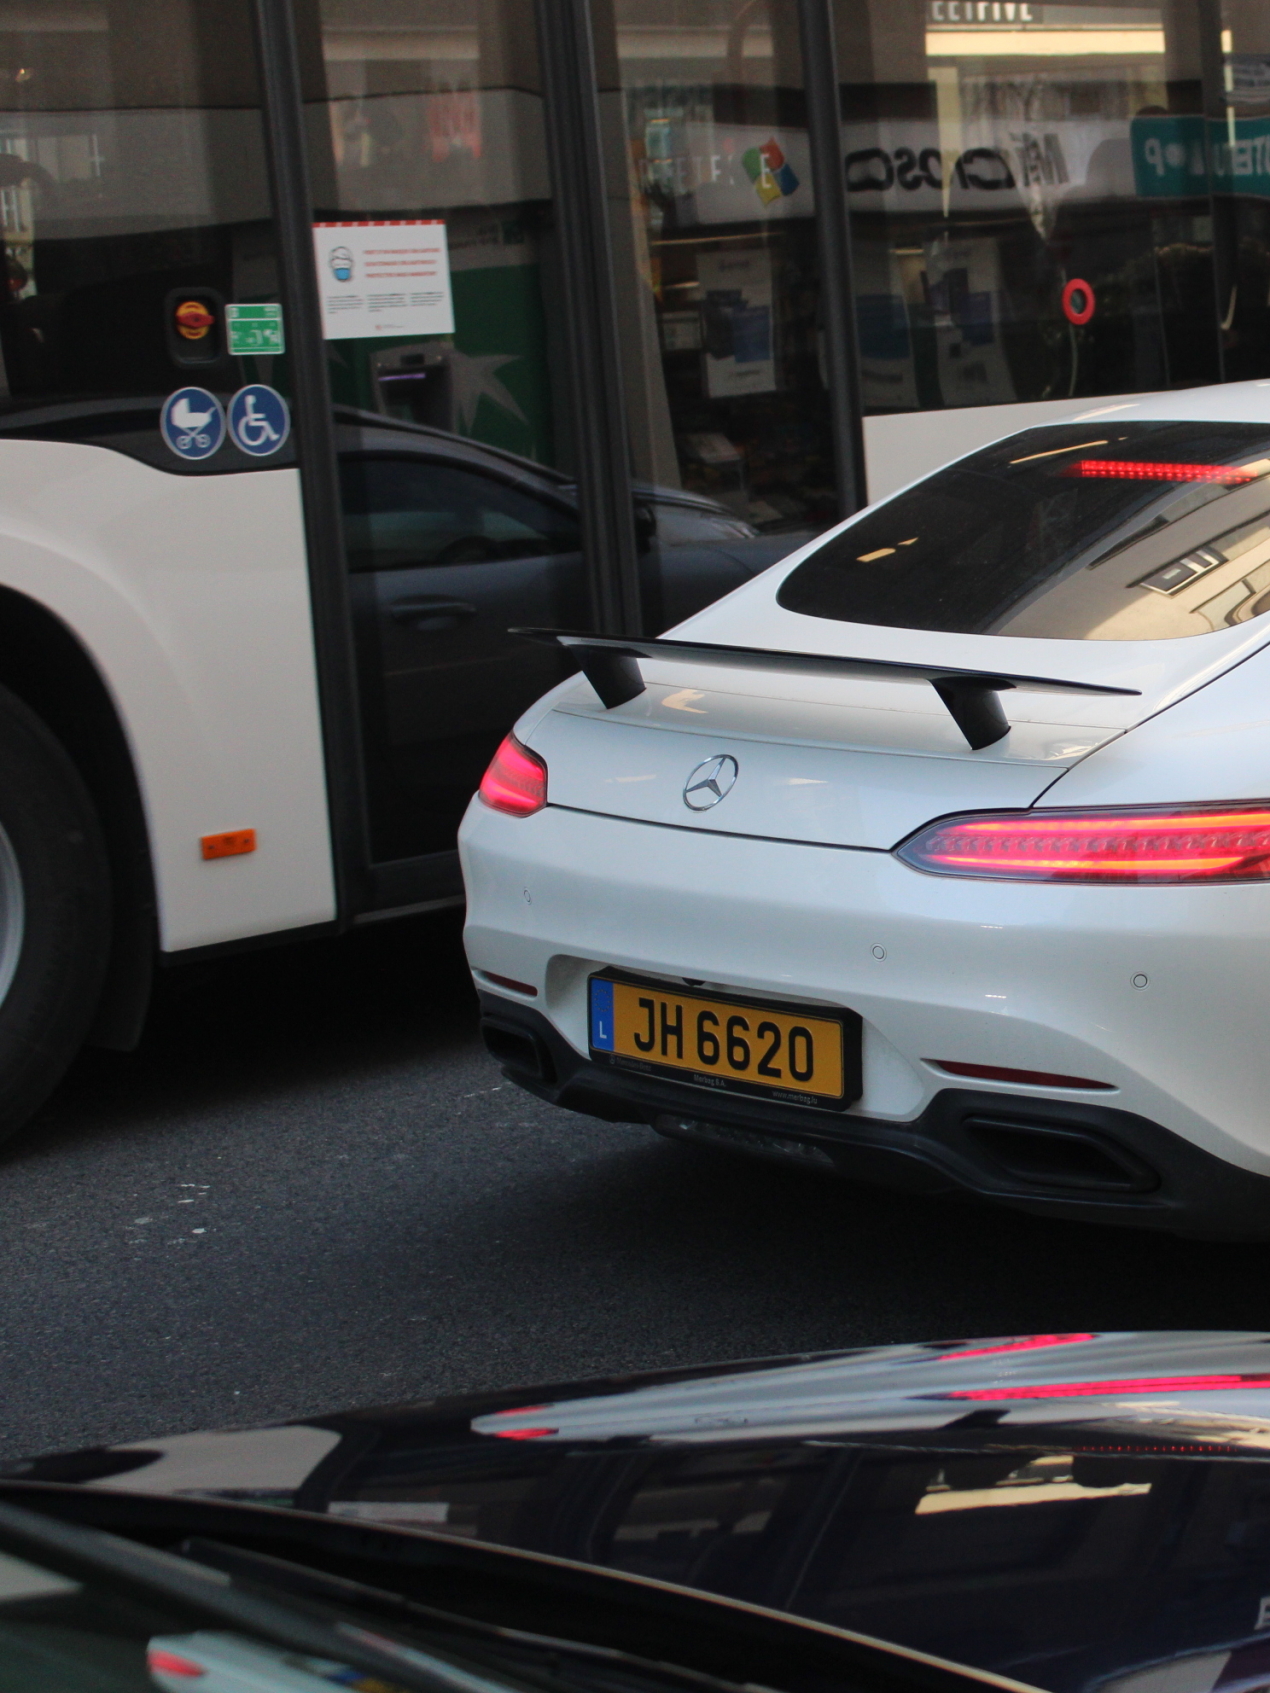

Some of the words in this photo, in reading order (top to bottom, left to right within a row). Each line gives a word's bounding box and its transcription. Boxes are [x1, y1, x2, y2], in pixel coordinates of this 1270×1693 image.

[599, 1020, 607, 1040] L
[633, 997, 683, 1060] JH
[697, 1010, 814, 1082] 6620
